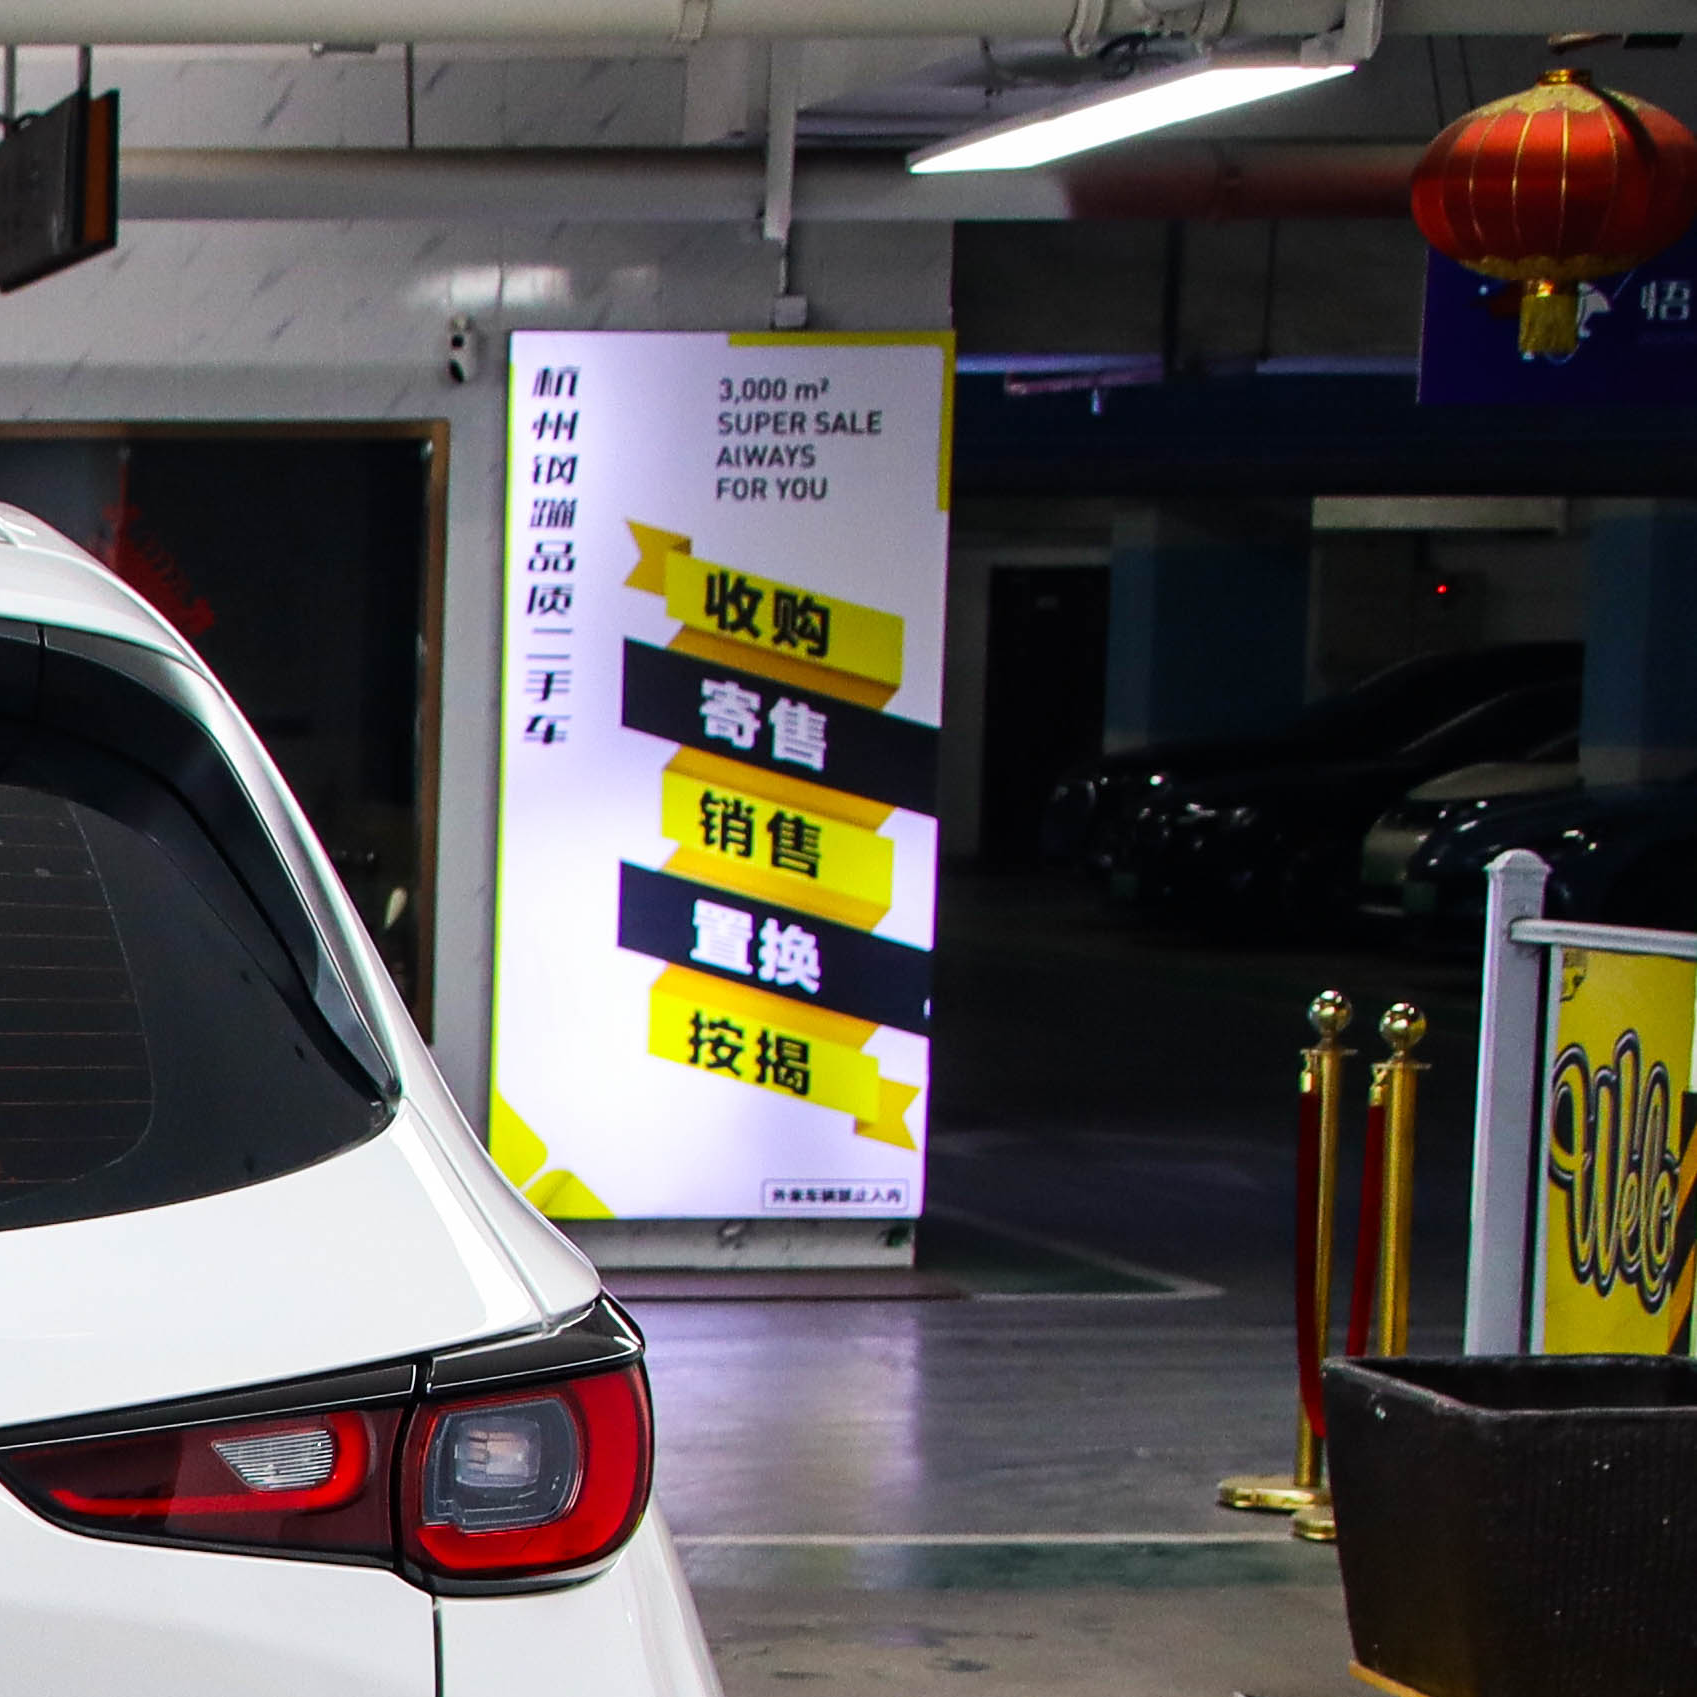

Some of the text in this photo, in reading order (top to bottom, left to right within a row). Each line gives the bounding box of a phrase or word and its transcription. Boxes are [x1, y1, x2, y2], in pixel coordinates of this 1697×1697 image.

[717, 408, 883, 436] SUPER SALE
[718, 376, 788, 405] 3,000
[716, 476, 829, 502] FOR YOU
[523, 366, 581, 745] 杭州钢蹦品质二手车
[703, 571, 831, 658] 收购
[699, 678, 828, 772] 寄售
[699, 790, 823, 879] 销售
[690, 898, 822, 995] 置换
[687, 1010, 812, 1097] 按揭
